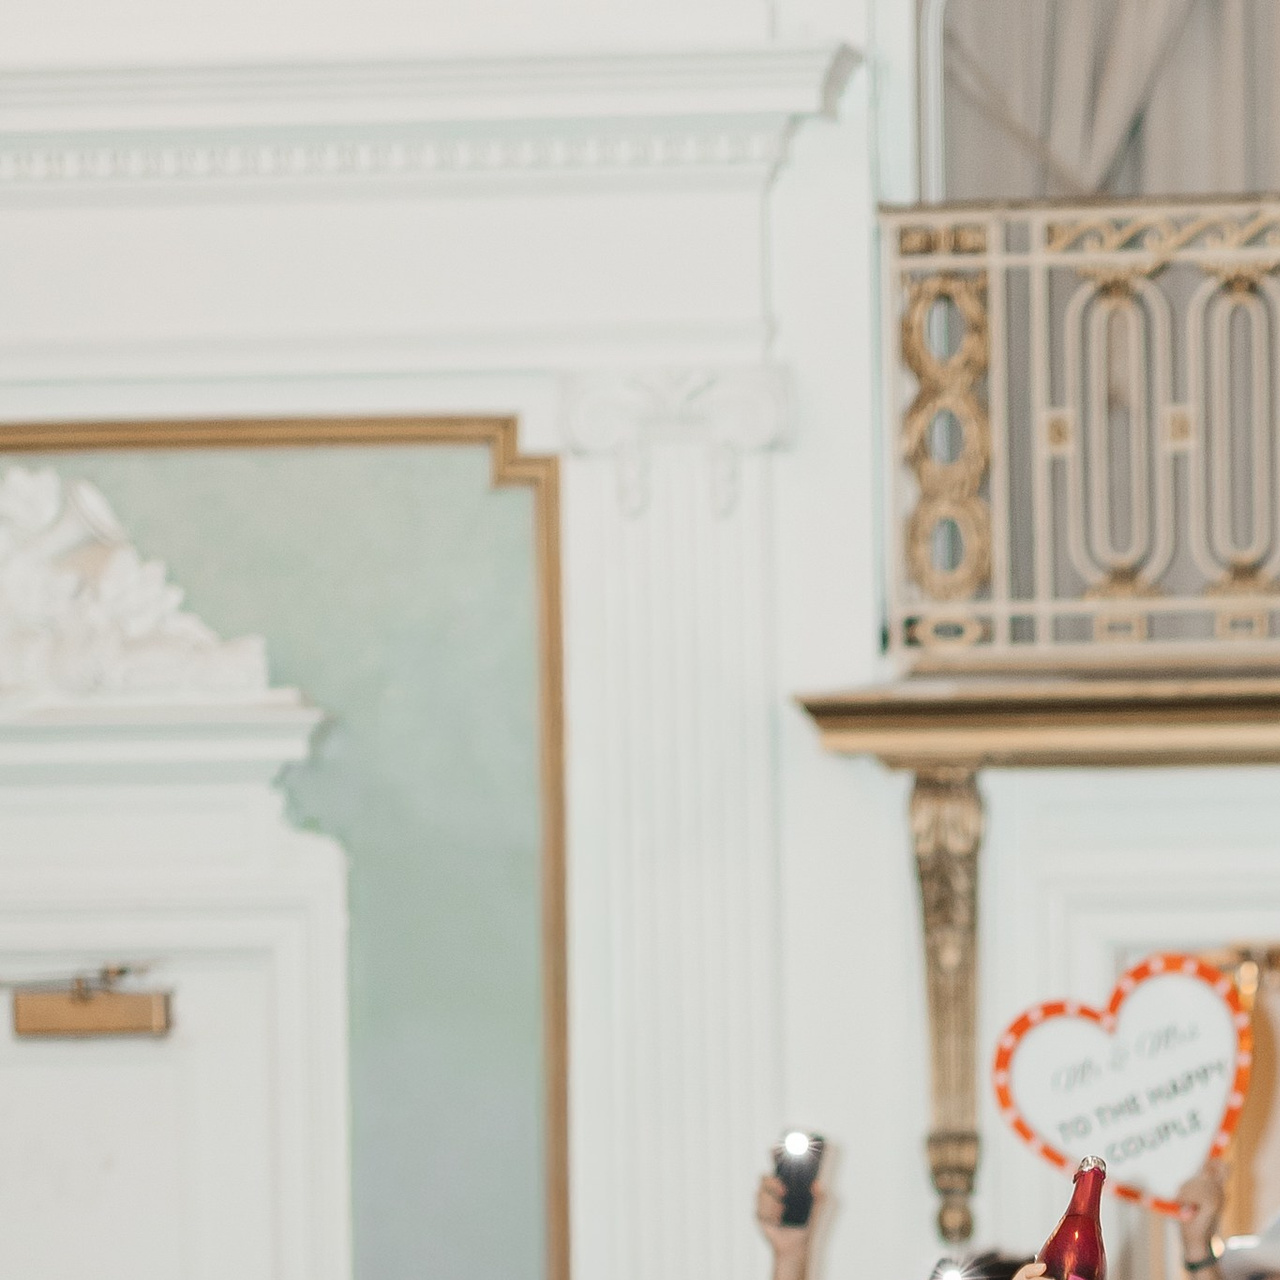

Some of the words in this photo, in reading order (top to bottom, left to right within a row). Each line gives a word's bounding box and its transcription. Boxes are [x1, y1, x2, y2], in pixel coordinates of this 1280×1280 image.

[1056, 1113, 1093, 1145] TO
[1093, 1091, 1142, 1126] THE
[1146, 1057, 1228, 1106] HAPPY
[1103, 1108, 1203, 1166] COUPLE
